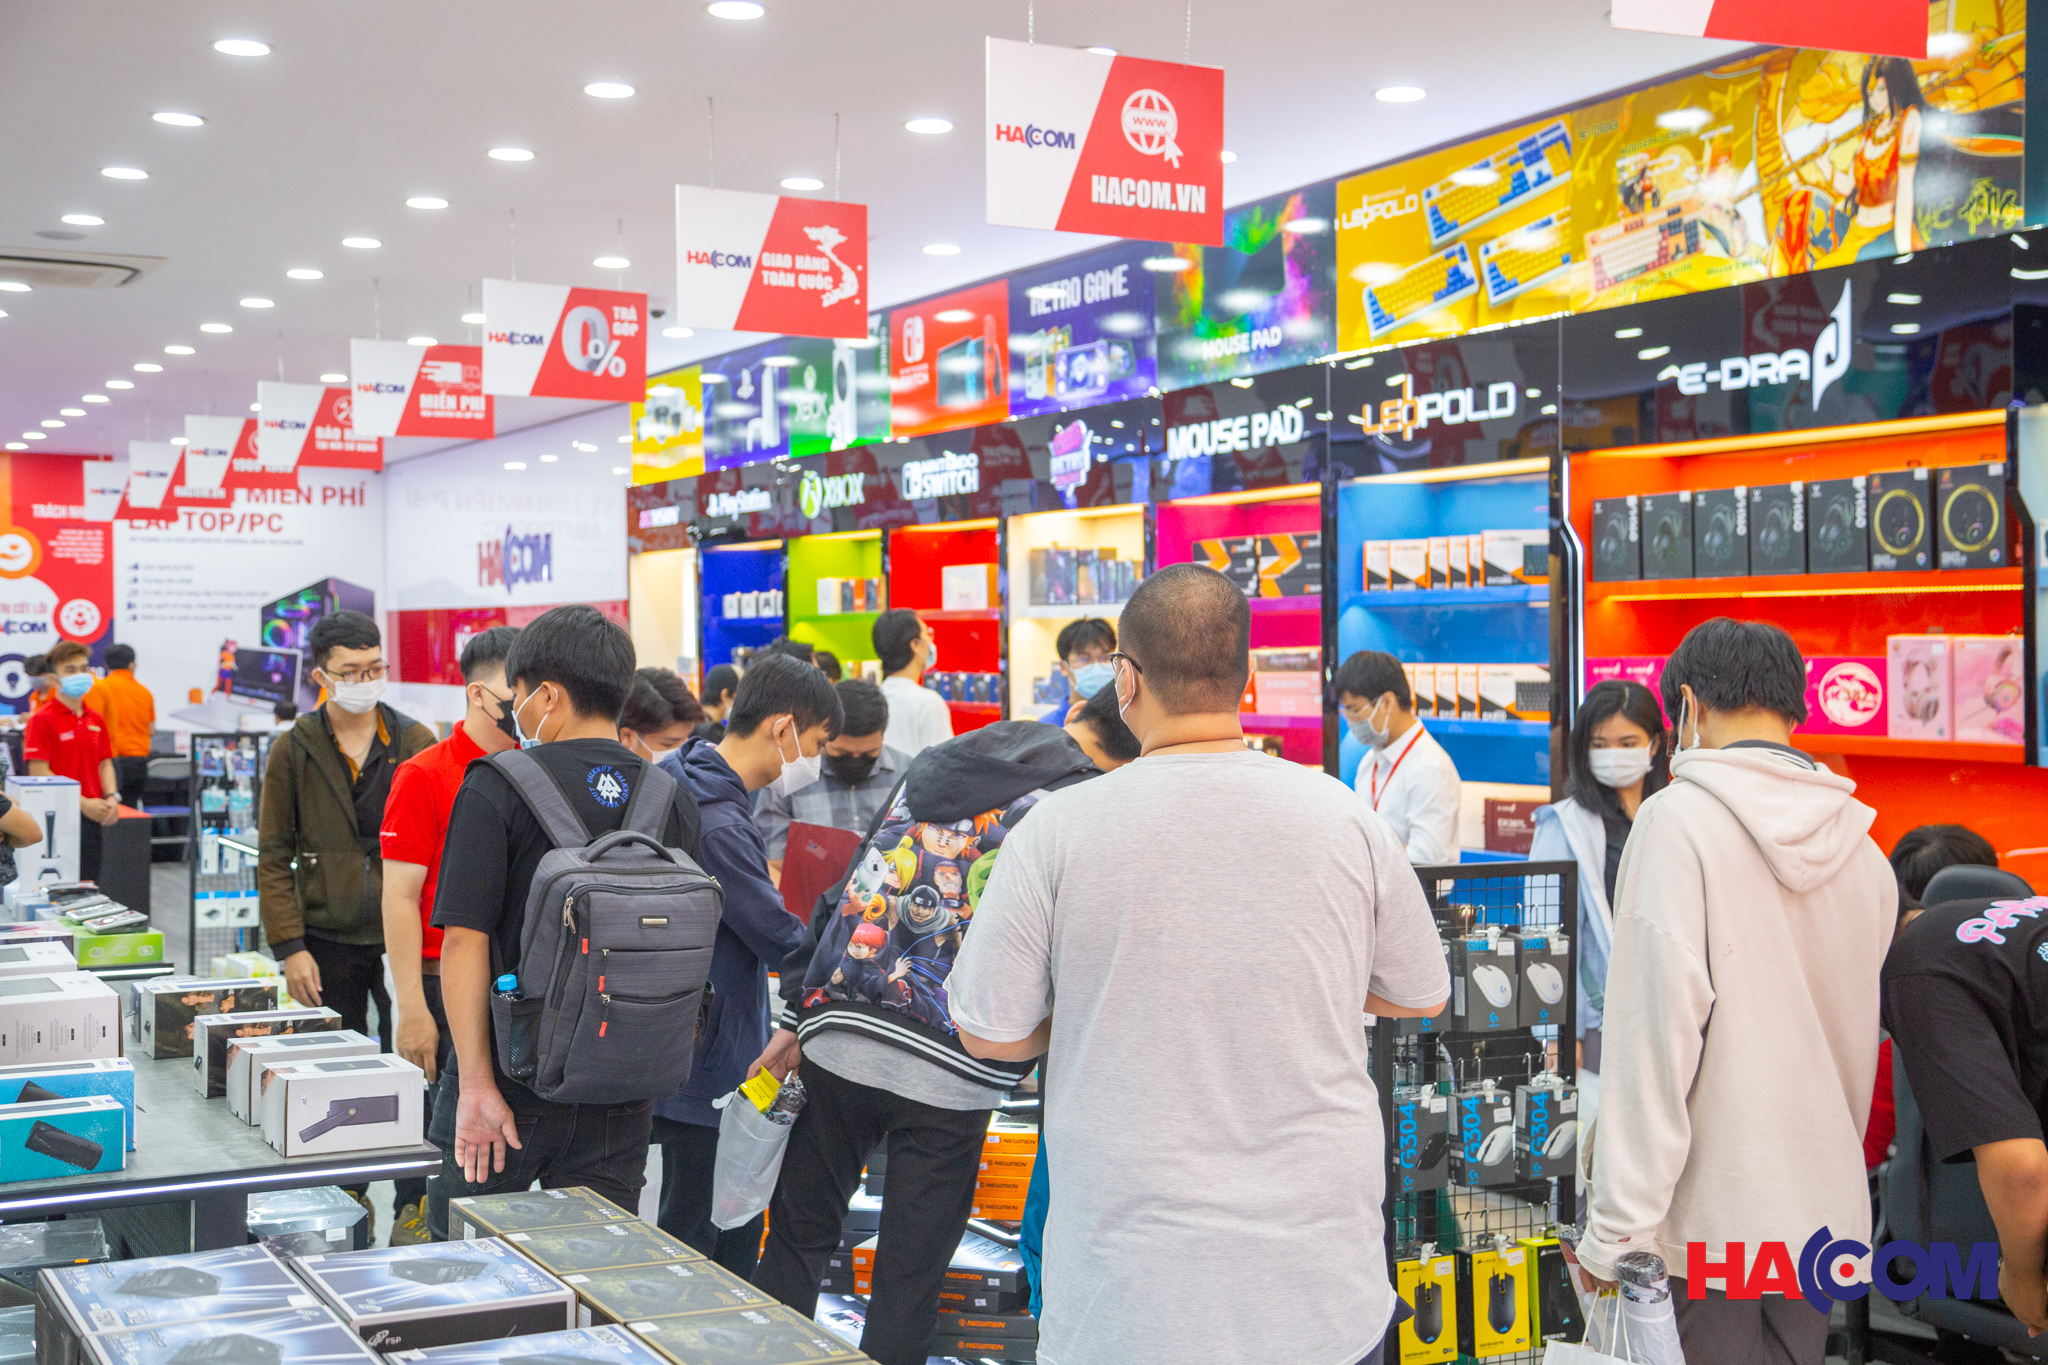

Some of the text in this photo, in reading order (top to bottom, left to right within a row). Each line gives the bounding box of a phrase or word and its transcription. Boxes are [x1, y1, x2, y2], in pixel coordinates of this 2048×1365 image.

[1091, 174, 1206, 214] HACOM.VN
[1342, 193, 1418, 230] LEOPOLD
[761, 252, 829, 272] GIAO HÀNG
[761, 270, 795, 287] TOÀN
[1029, 264, 1130, 317] RETRO GAME
[1202, 326, 1283, 360] MOUSE PAD
[1362, 374, 1516, 441] LEOPOLD
[1167, 408, 1305, 461] MOUSE PAD
[322, 481, 366, 506] PHÍ
[822, 472, 866, 508] XBOX
[922, 468, 980, 498] SWITCH
[614, 770, 630, 803] VALKNUT
[1523, 938, 1546, 949] G102
[1399, 1101, 1418, 1170] G304
[1461, 1095, 1482, 1164] G304
[1530, 1091, 1549, 1157] G304
[1003, 1138, 1036, 1146] NEWMEN
[994, 1160, 1027, 1168] NEWMEN
[945, 1272, 983, 1281] NEWMEN
[967, 1320, 1006, 1329] NEWMEN
[386, 1336, 402, 1345] FSP
[966, 1342, 1004, 1351] NEWMEN
